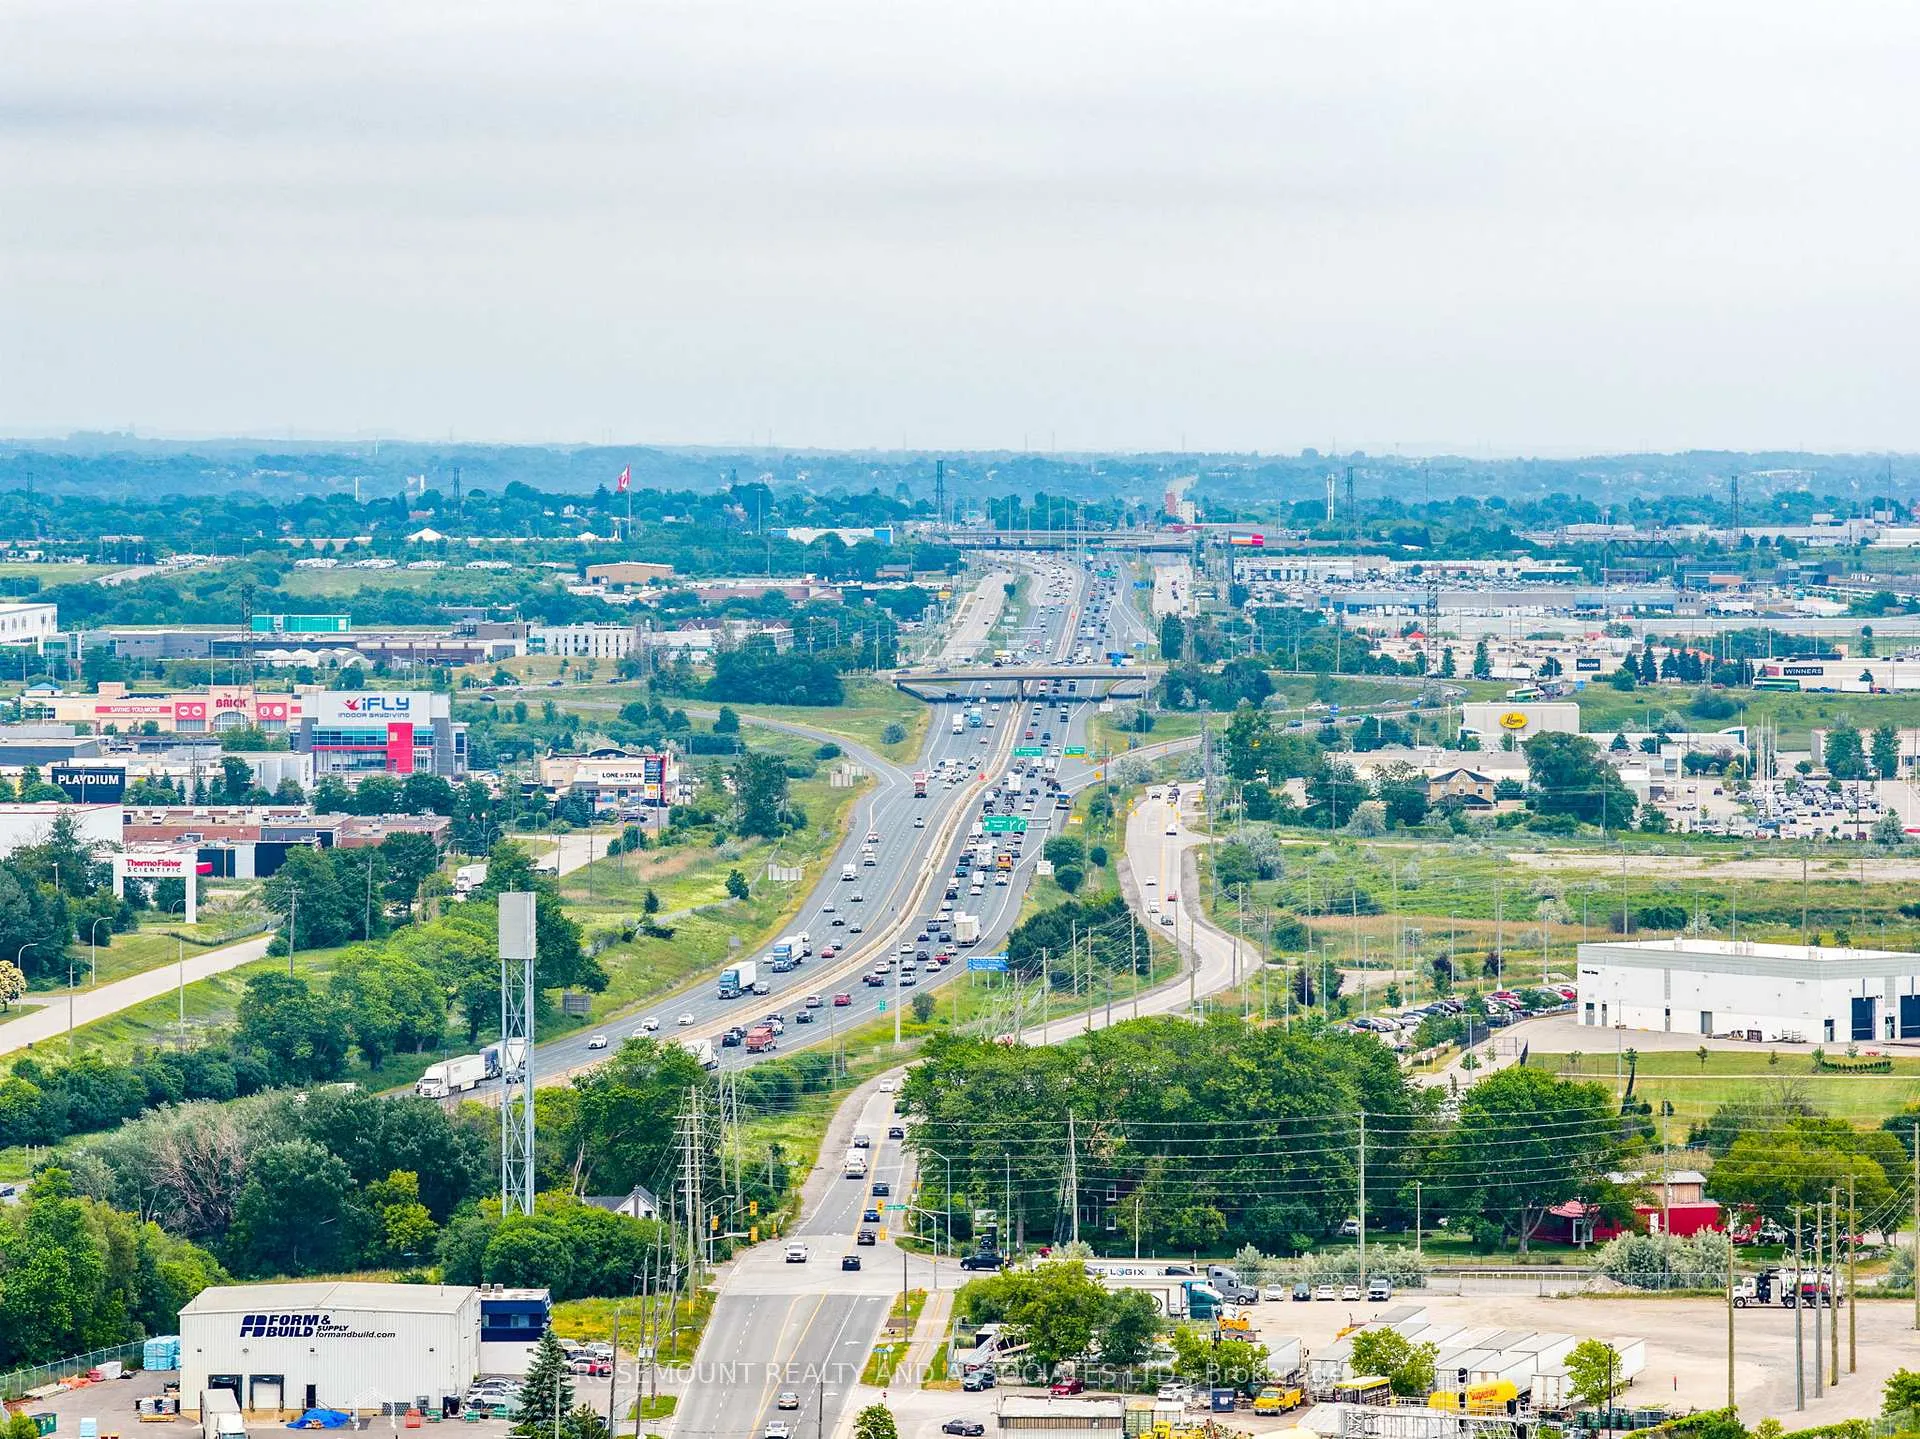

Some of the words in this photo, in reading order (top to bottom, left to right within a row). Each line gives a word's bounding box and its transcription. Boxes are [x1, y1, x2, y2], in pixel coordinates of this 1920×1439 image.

[215, 698, 247, 708] BRICK
[57, 774, 119, 785] PLAYDIUM
[268, 1314, 319, 1326] FORM
[320, 1314, 331, 1325] &
[266, 1326, 314, 1338] BUILD
